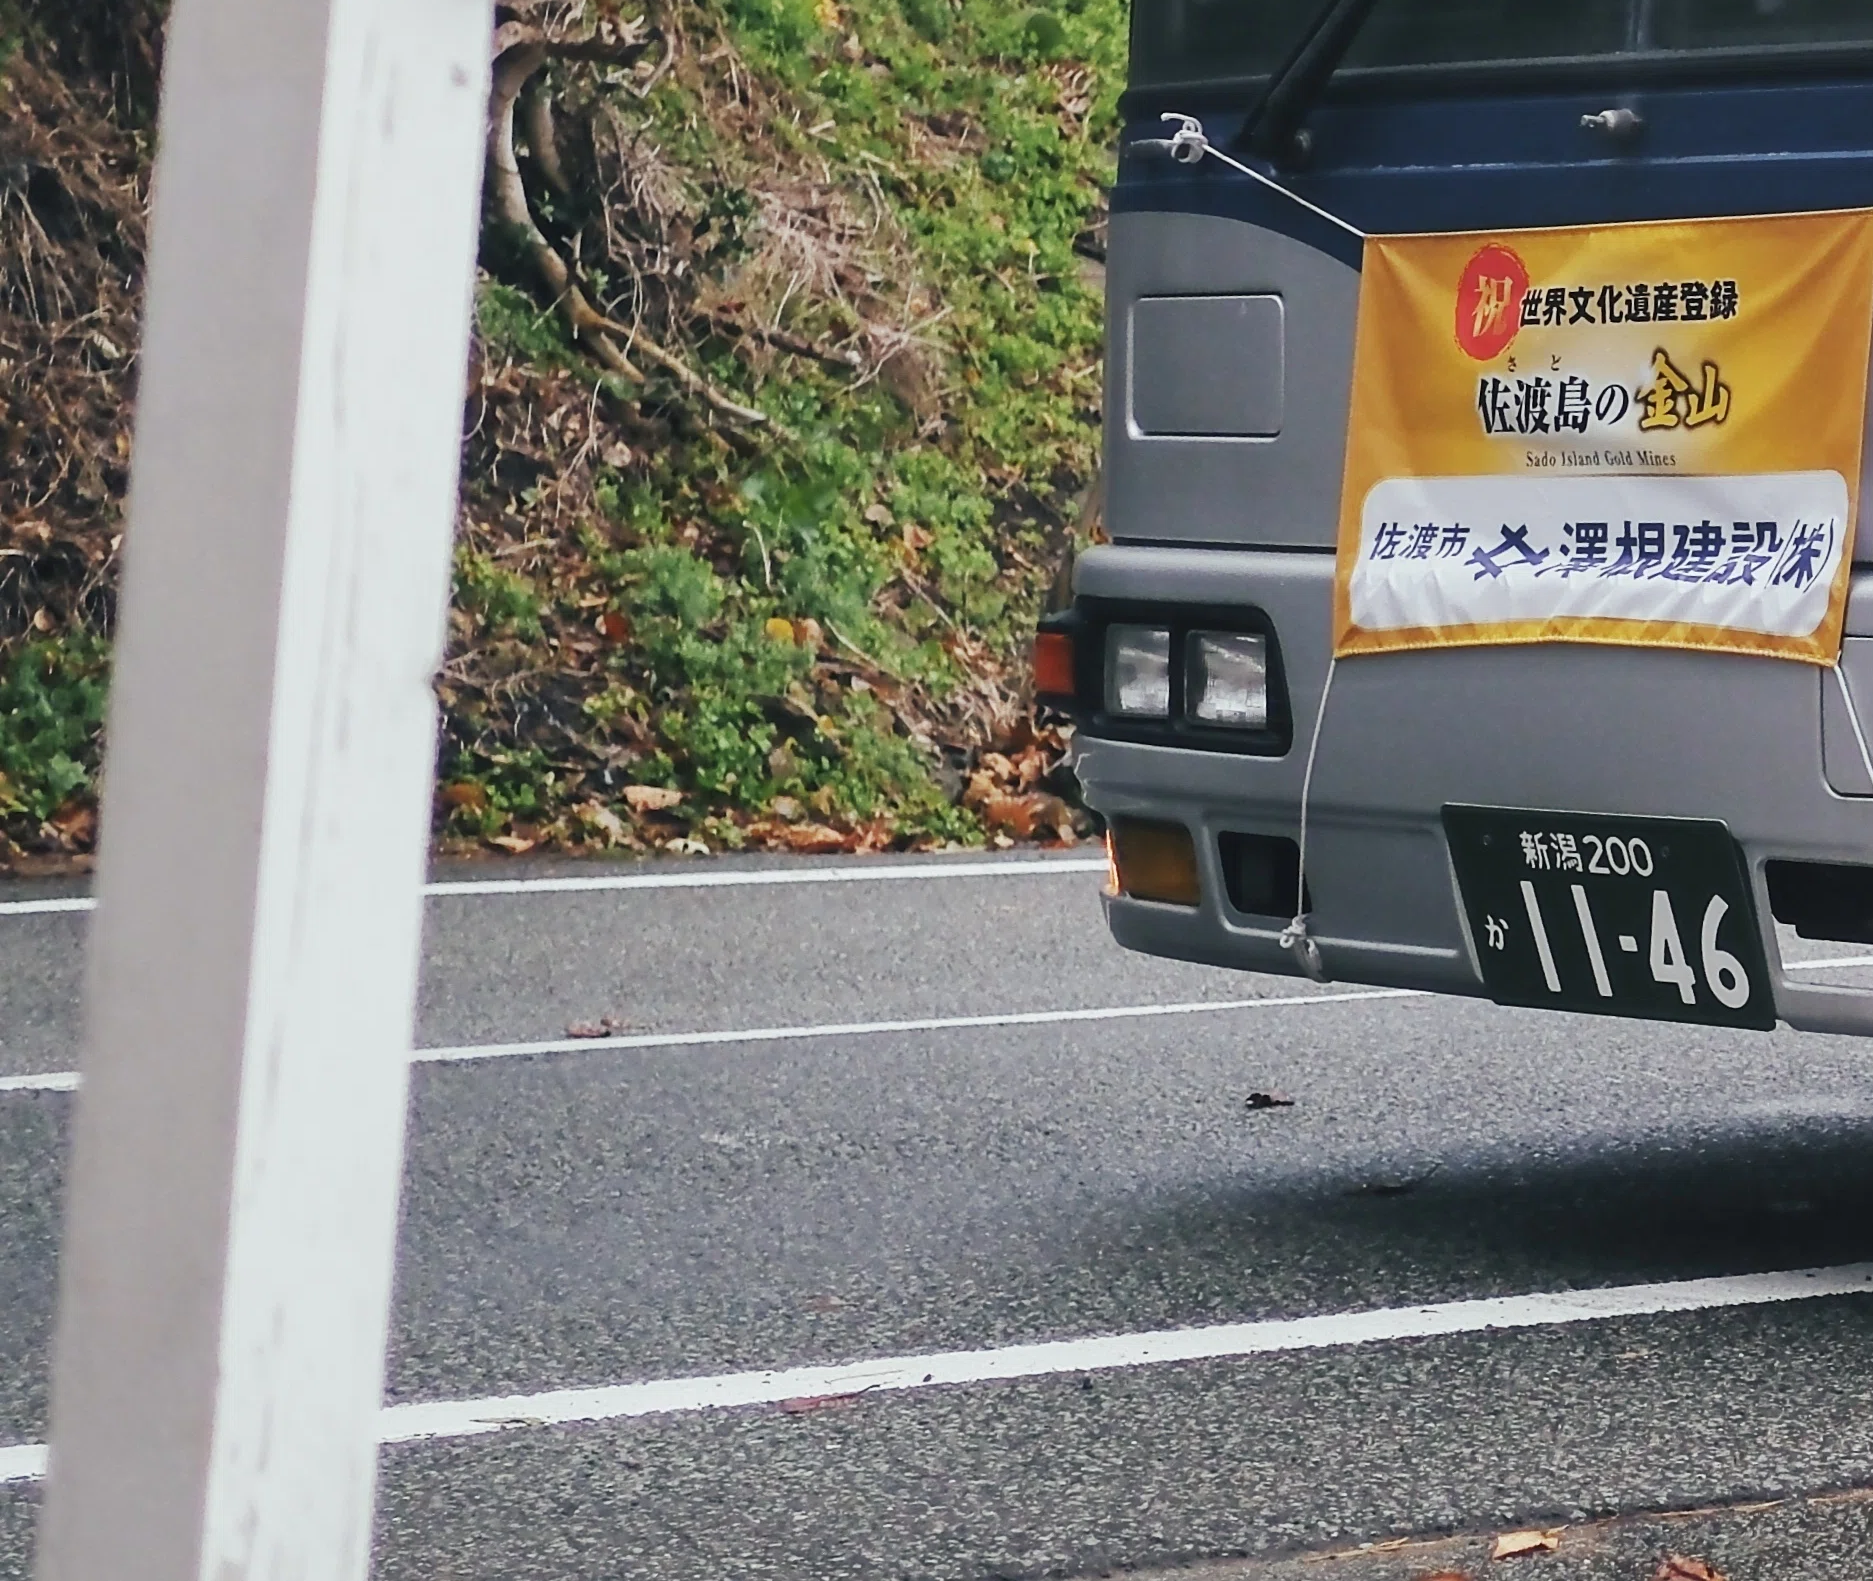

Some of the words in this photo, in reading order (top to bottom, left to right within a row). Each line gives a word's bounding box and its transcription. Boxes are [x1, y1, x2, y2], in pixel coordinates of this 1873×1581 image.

[1472, 273, 1513, 338] 祝
[1519, 281, 1739, 326] 世界文化遺産登録
[1526, 451, 1557, 468] Sado
[1562, 450, 1600, 467] Island
[1605, 450, 1634, 467] Gold
[1638, 451, 1677, 467] Mines
[1371, 522, 1470, 561] 佐渡市
[1484, 914, 1510, 951] か
[1519, 880, 1751, 1009] 11-46
